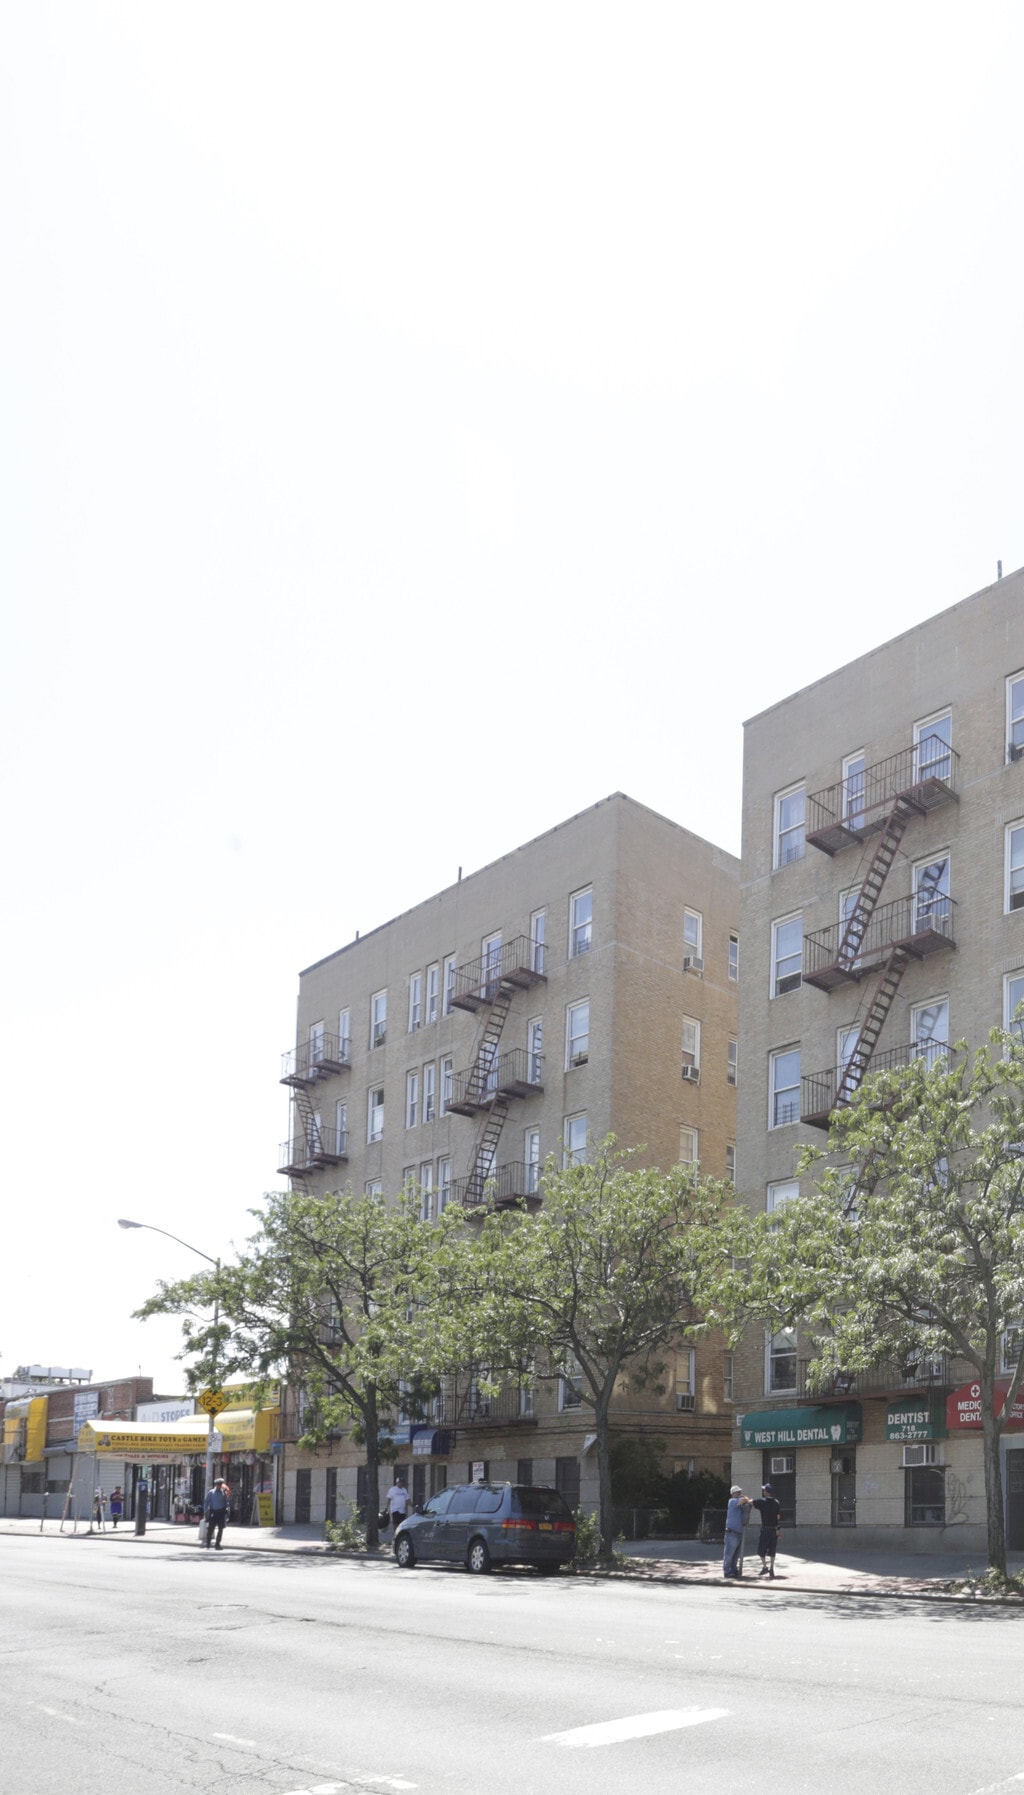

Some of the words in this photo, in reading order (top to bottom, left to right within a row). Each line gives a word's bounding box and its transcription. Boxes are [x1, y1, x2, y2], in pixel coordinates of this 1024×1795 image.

[957, 1400, 982, 1411] MEDIC
[888, 1411, 929, 1425] DENTIST
[754, 1431, 776, 1443] WEST
[777, 1430, 796, 1442] HILL
[797, 1428, 829, 1441] DENTAL
[890, 1431, 928, 1440] 863-2777
